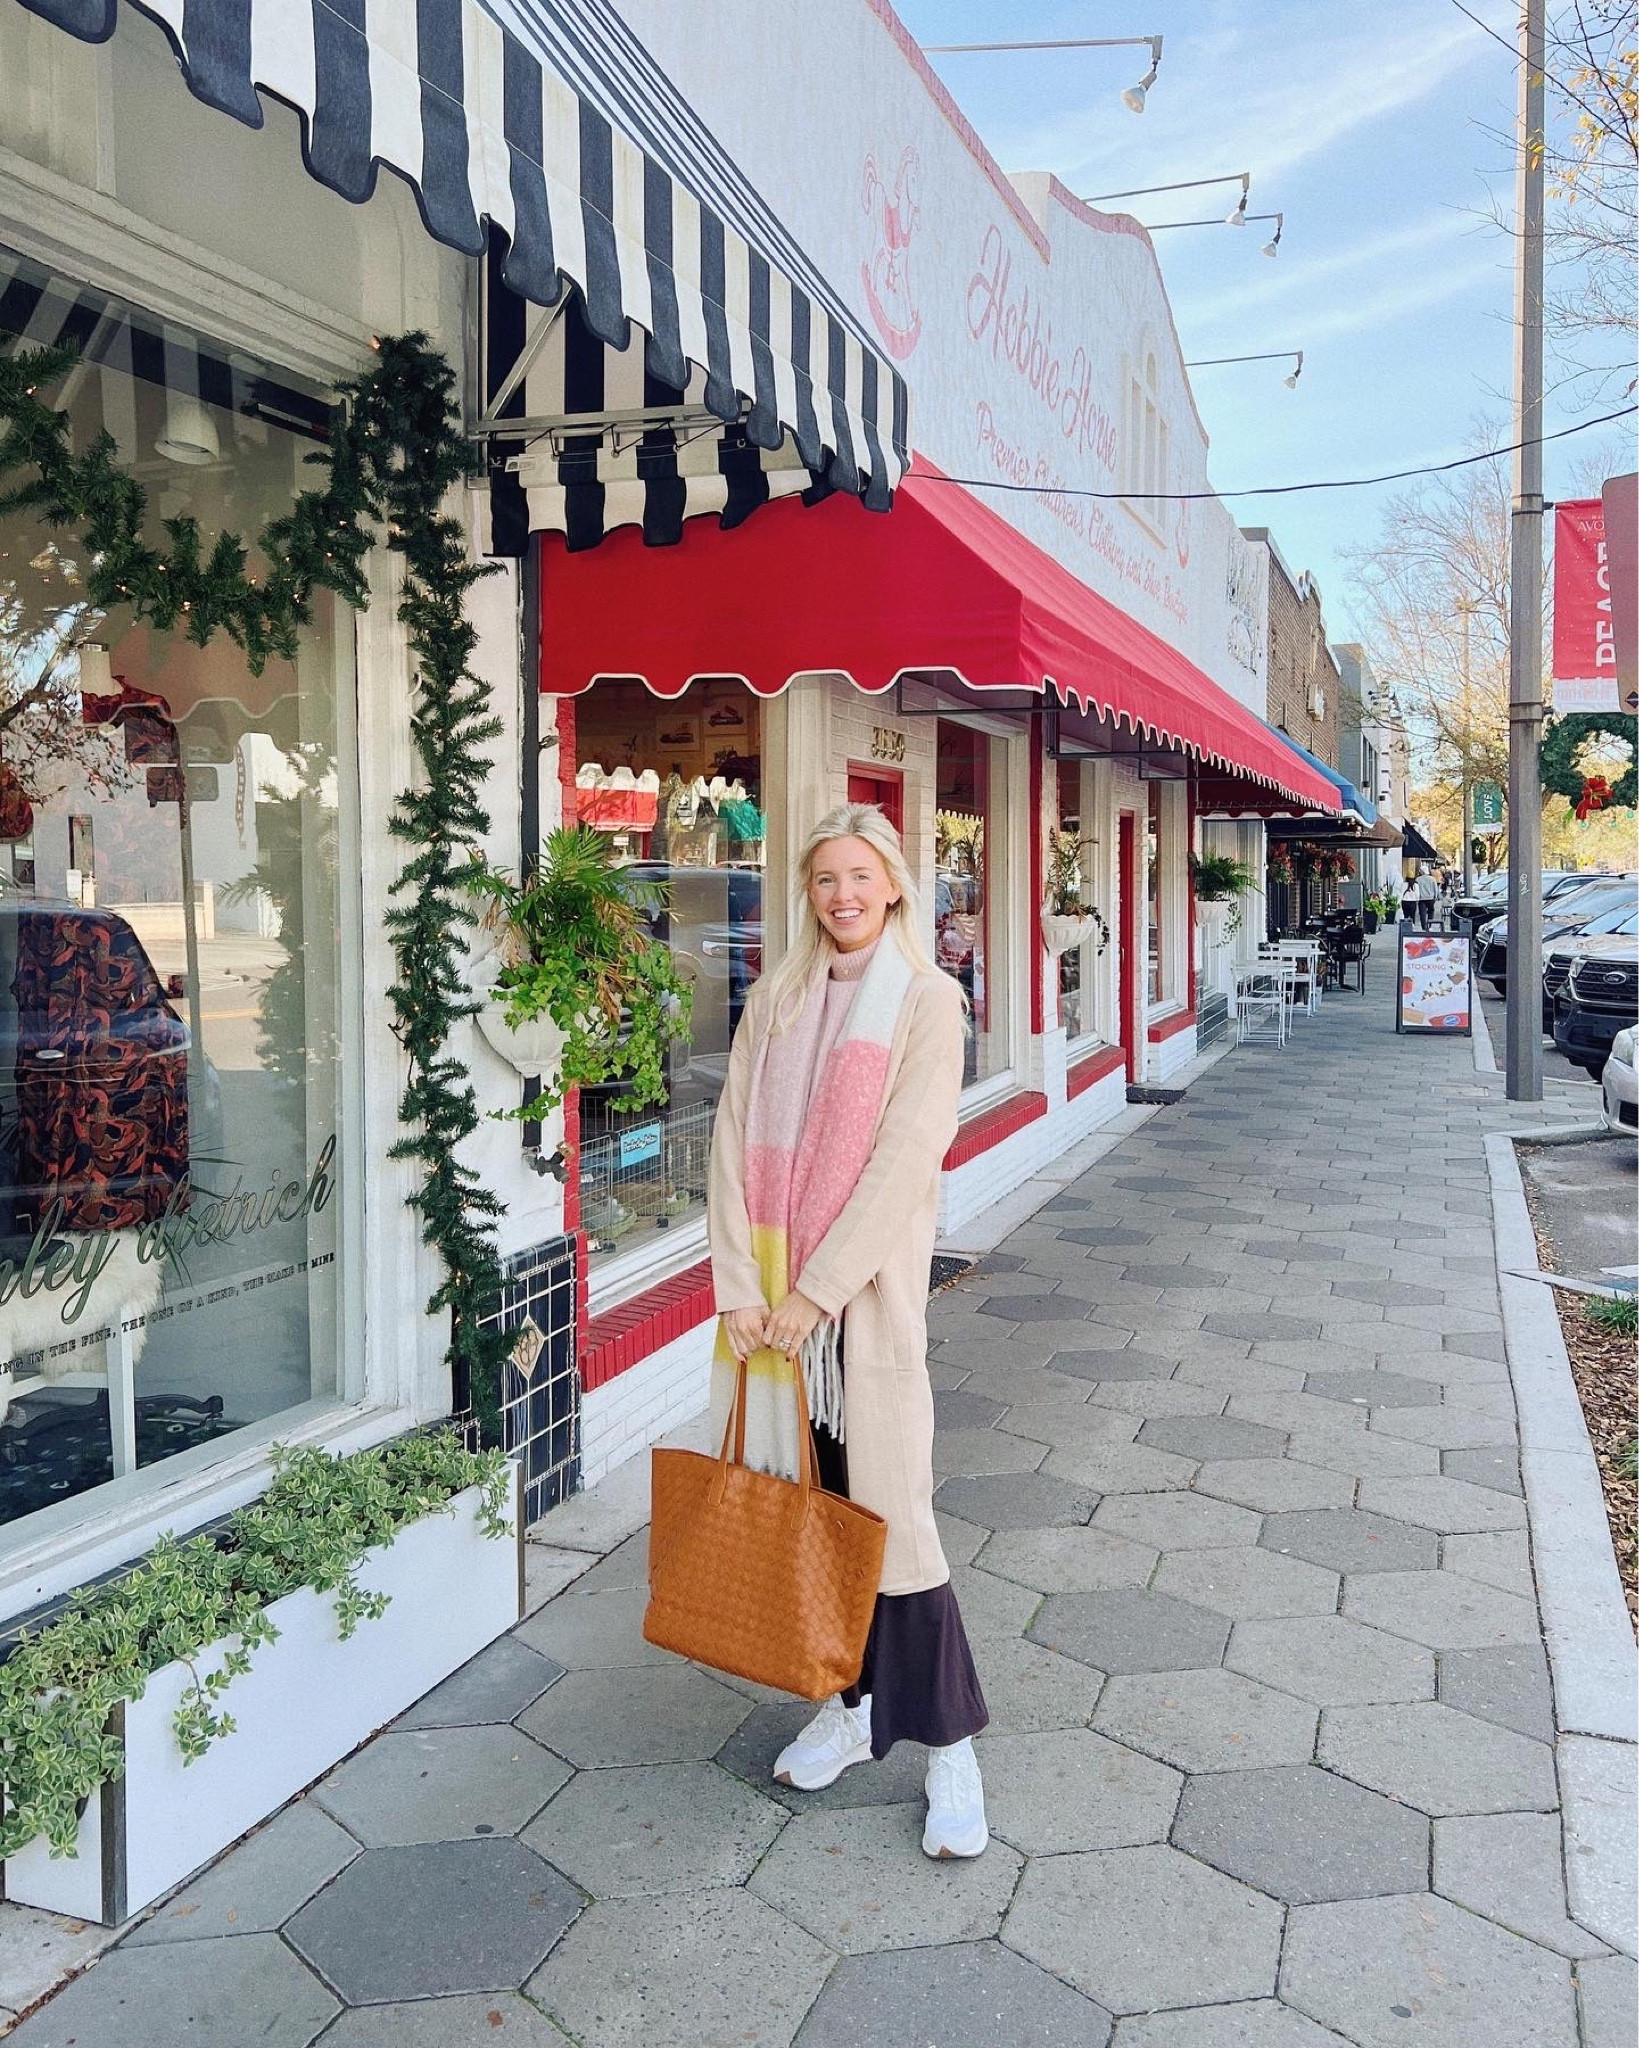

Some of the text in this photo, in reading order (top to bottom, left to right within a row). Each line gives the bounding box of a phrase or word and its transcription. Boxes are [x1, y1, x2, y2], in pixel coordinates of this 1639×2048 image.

[1596, 542, 1616, 667] PEA
[1483, 793, 1493, 819] LOVE
[137, 1133, 337, 1265] dietrich
[50, 1339, 76, 1358] THE
[121, 1316, 146, 1333] THE
[150, 1305, 174, 1323] ONE
[178, 1300, 193, 1314] OF
[197, 1296, 205, 1308] A
[243, 1276, 264, 1291] THE
[267, 1264, 294, 1283] MAKE
[311, 1252, 335, 1269] MINE
